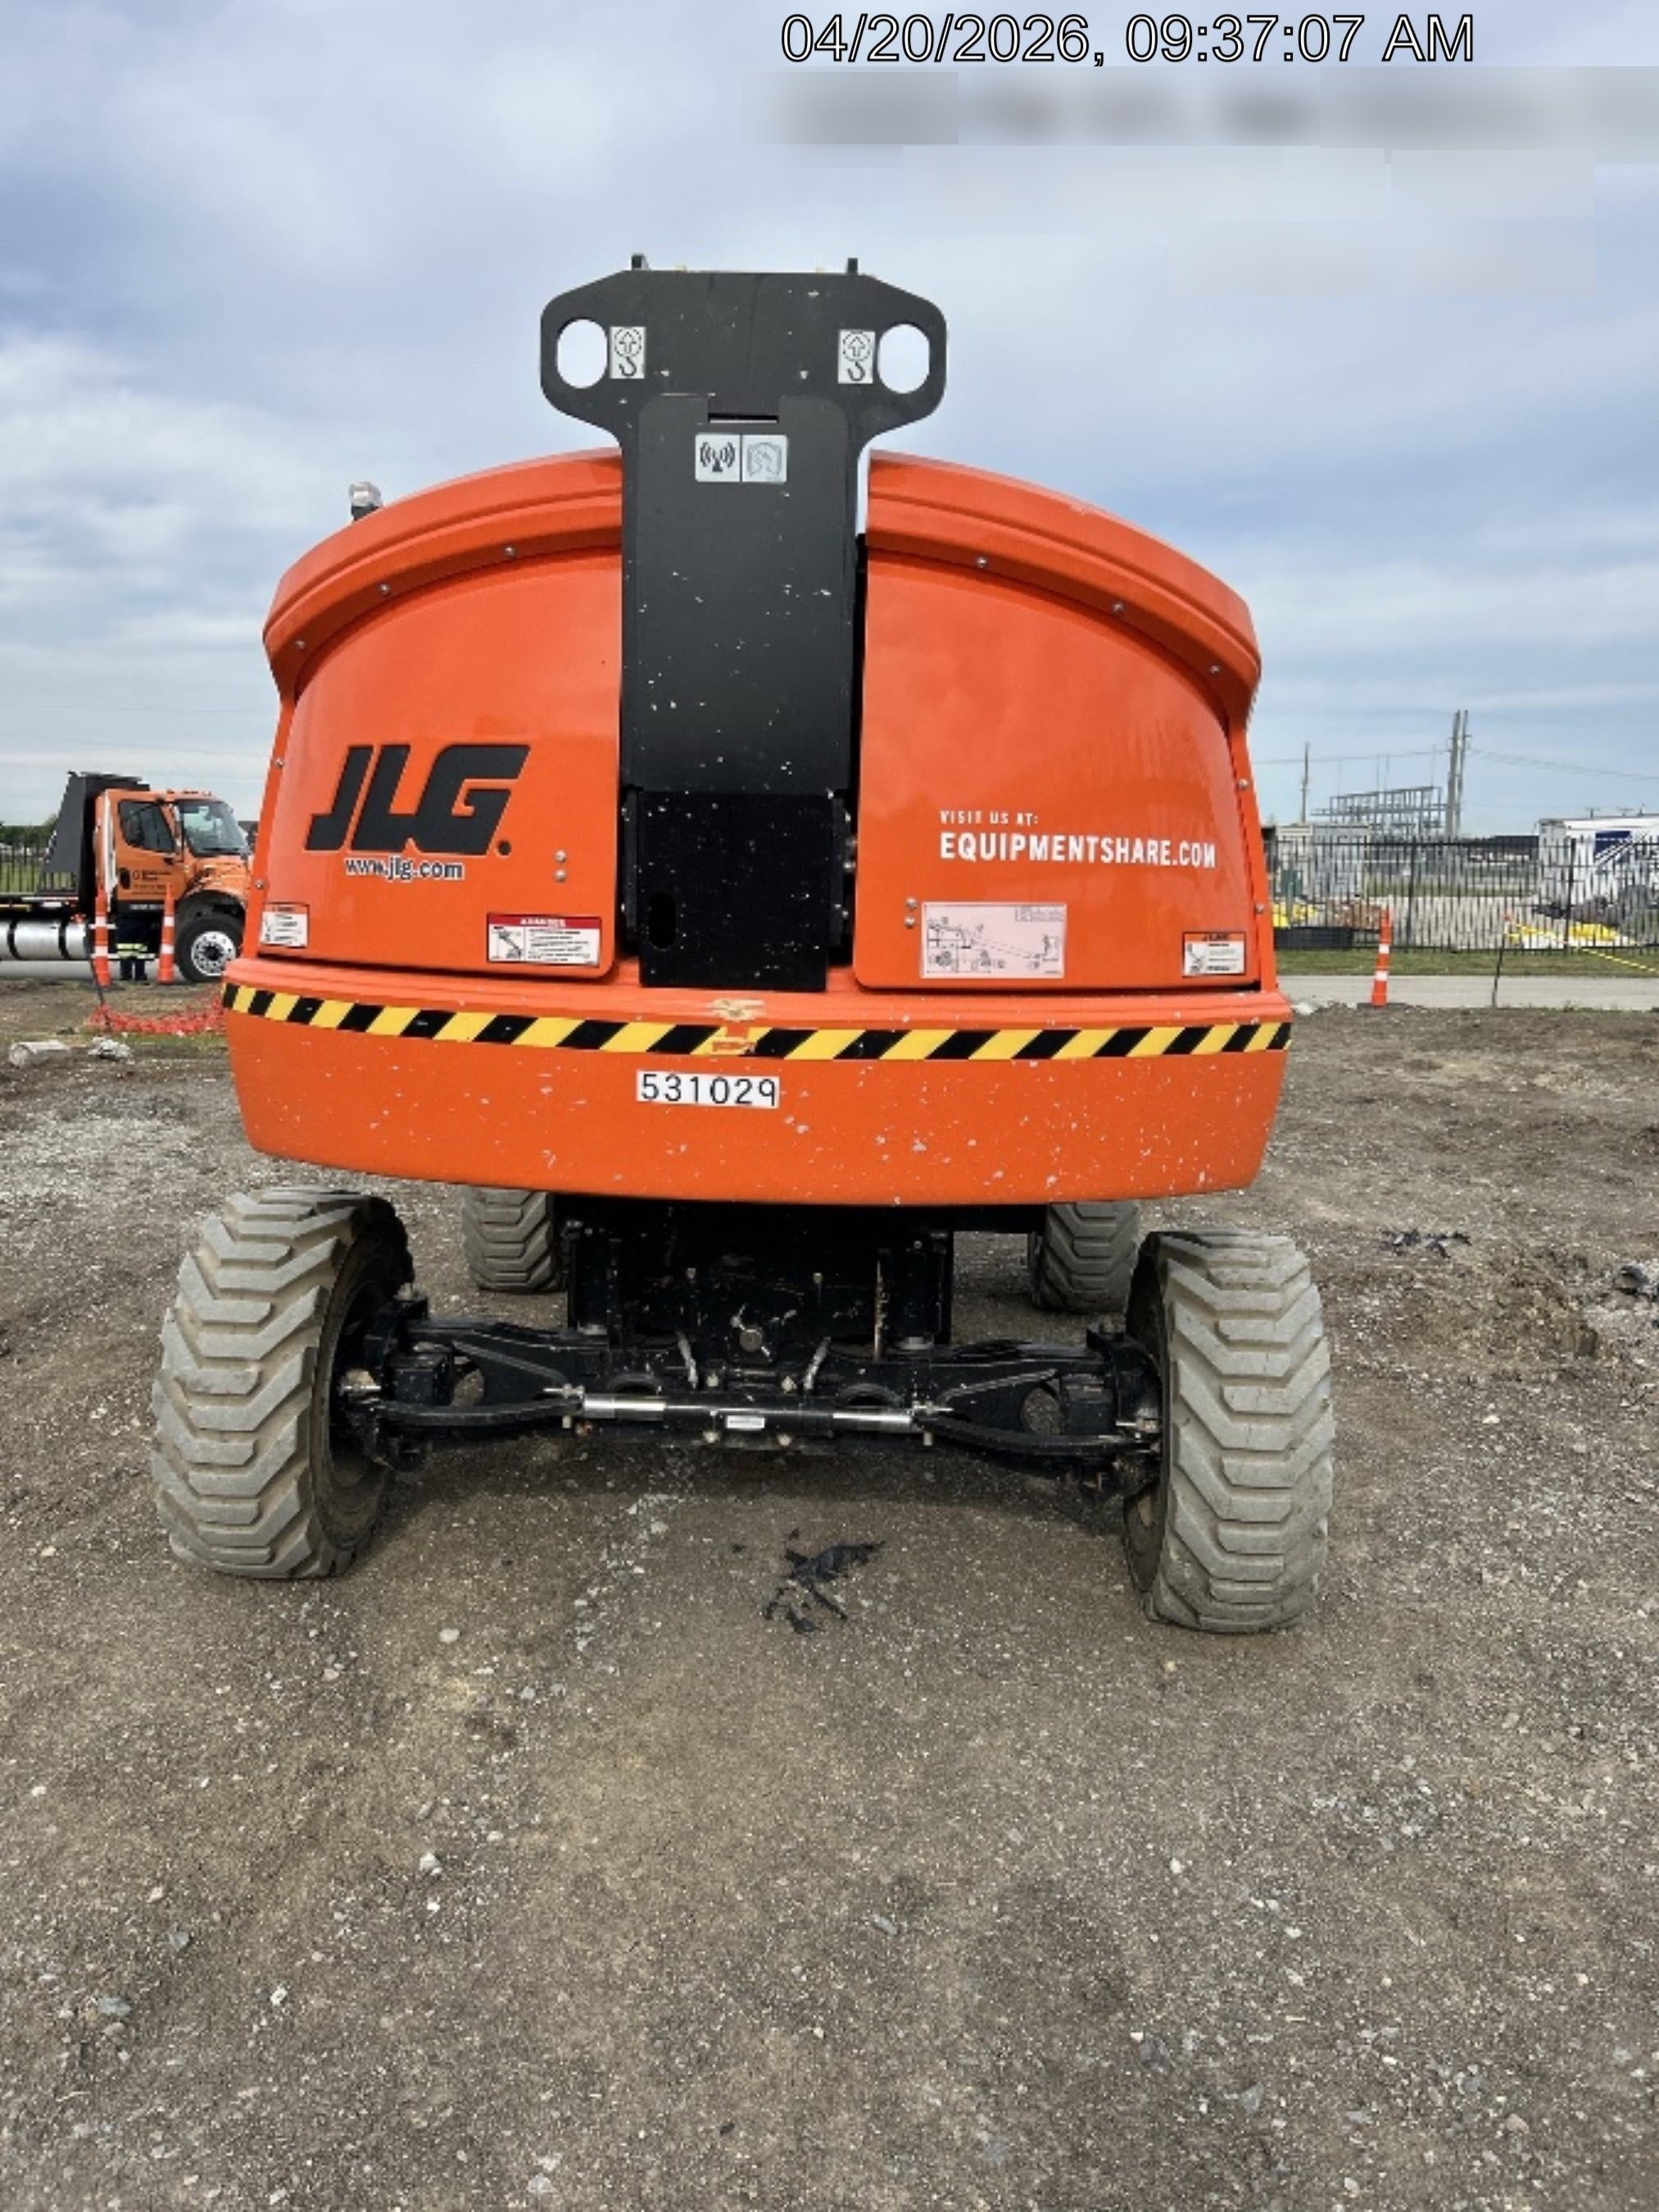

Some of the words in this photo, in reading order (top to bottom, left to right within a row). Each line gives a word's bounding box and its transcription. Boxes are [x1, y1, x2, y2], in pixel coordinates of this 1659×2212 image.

[940, 809, 983, 824] VISIT
[989, 810, 1009, 825] US
[1016, 811, 1039, 827] AT:
[940, 832, 1217, 868] EQUIPMENTSHARE.COM
[345, 855, 465, 881] www.jlg.com
[640, 1072, 776, 1107] 531029
